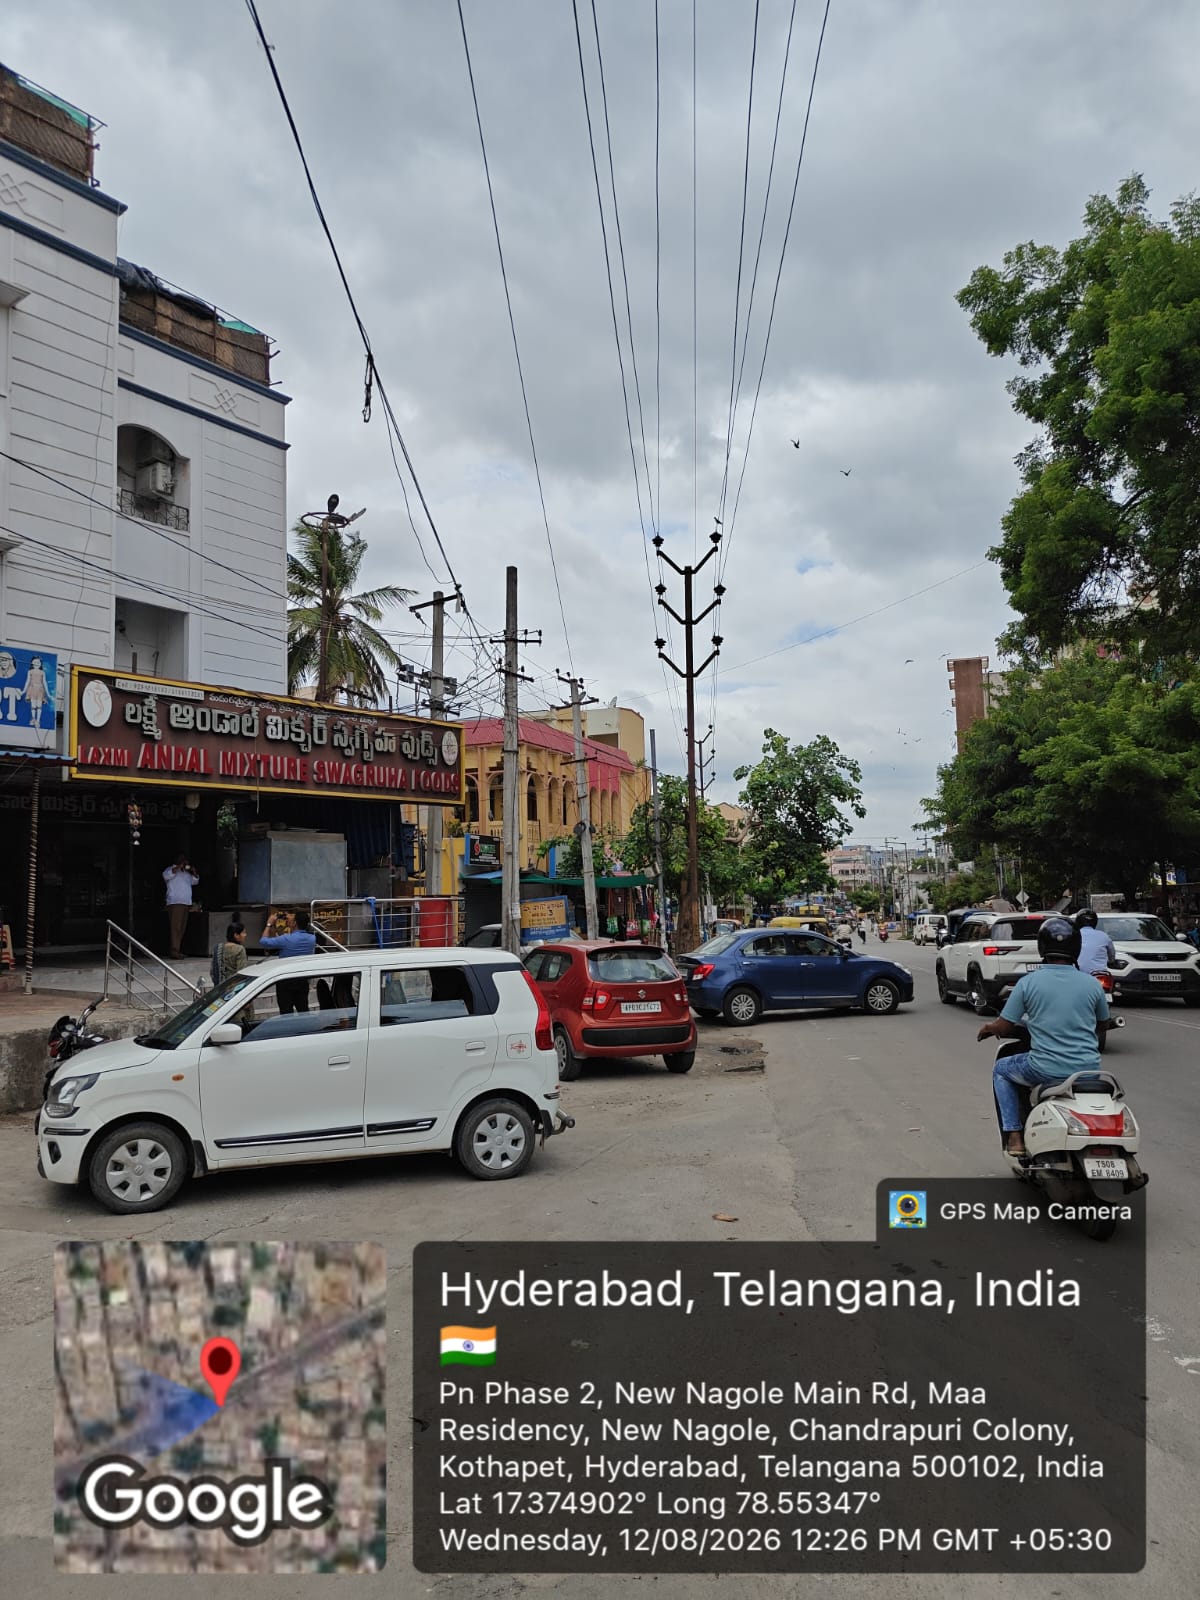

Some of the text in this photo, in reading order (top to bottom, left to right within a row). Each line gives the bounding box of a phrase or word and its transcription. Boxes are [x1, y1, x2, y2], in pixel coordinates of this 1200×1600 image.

[0, 687, 21, 721] T
[169, 703, 260, 738] ఆండాల్
[78, 742, 460, 794] LAXMI ANDAL MIXTURE SWAGRUHA FOODS
[1091, 1169, 1125, 1178] EM 8409
[1096, 1160, 1115, 1168] TS08
